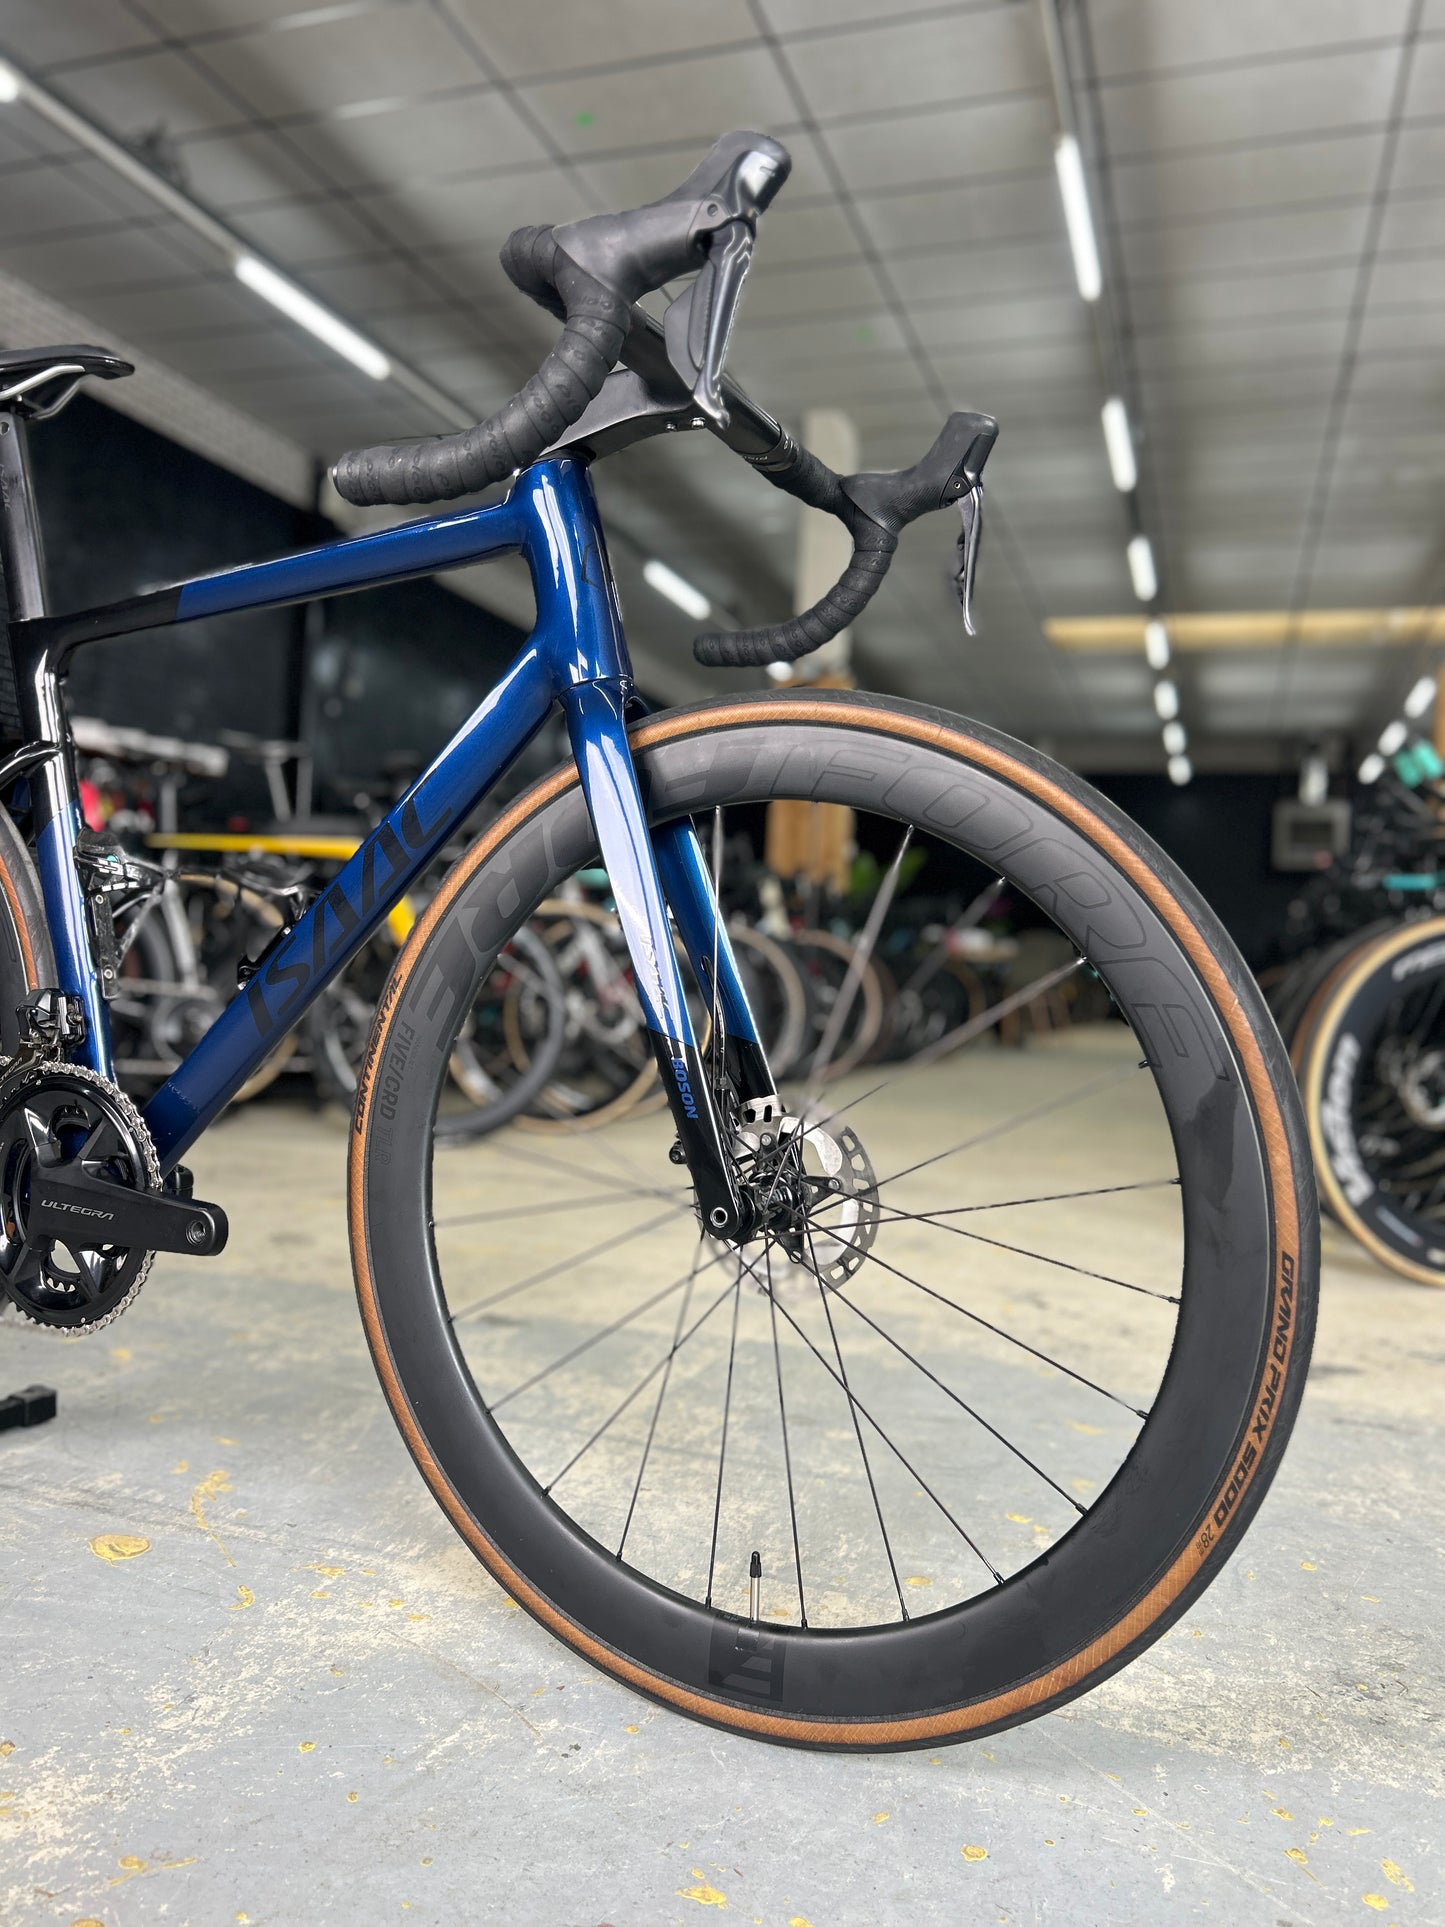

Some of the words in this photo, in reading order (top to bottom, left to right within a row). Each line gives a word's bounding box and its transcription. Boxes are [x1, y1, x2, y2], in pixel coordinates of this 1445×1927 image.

[246, 797, 452, 1038] ISAAC
[769, 736, 1230, 1082] FORE
[354, 974, 402, 1136] CONTINENTAL
[379, 1020, 416, 1121] FIVE/CRD
[671, 1057, 698, 1119] BOSON
[374, 1125, 394, 1166] TLR
[41, 1199, 114, 1221] ULTEGRA
[1273, 1251, 1295, 1365] GRAND
[1252, 1365, 1281, 1443] PRIX
[1213, 1442, 1258, 1528] 5000
